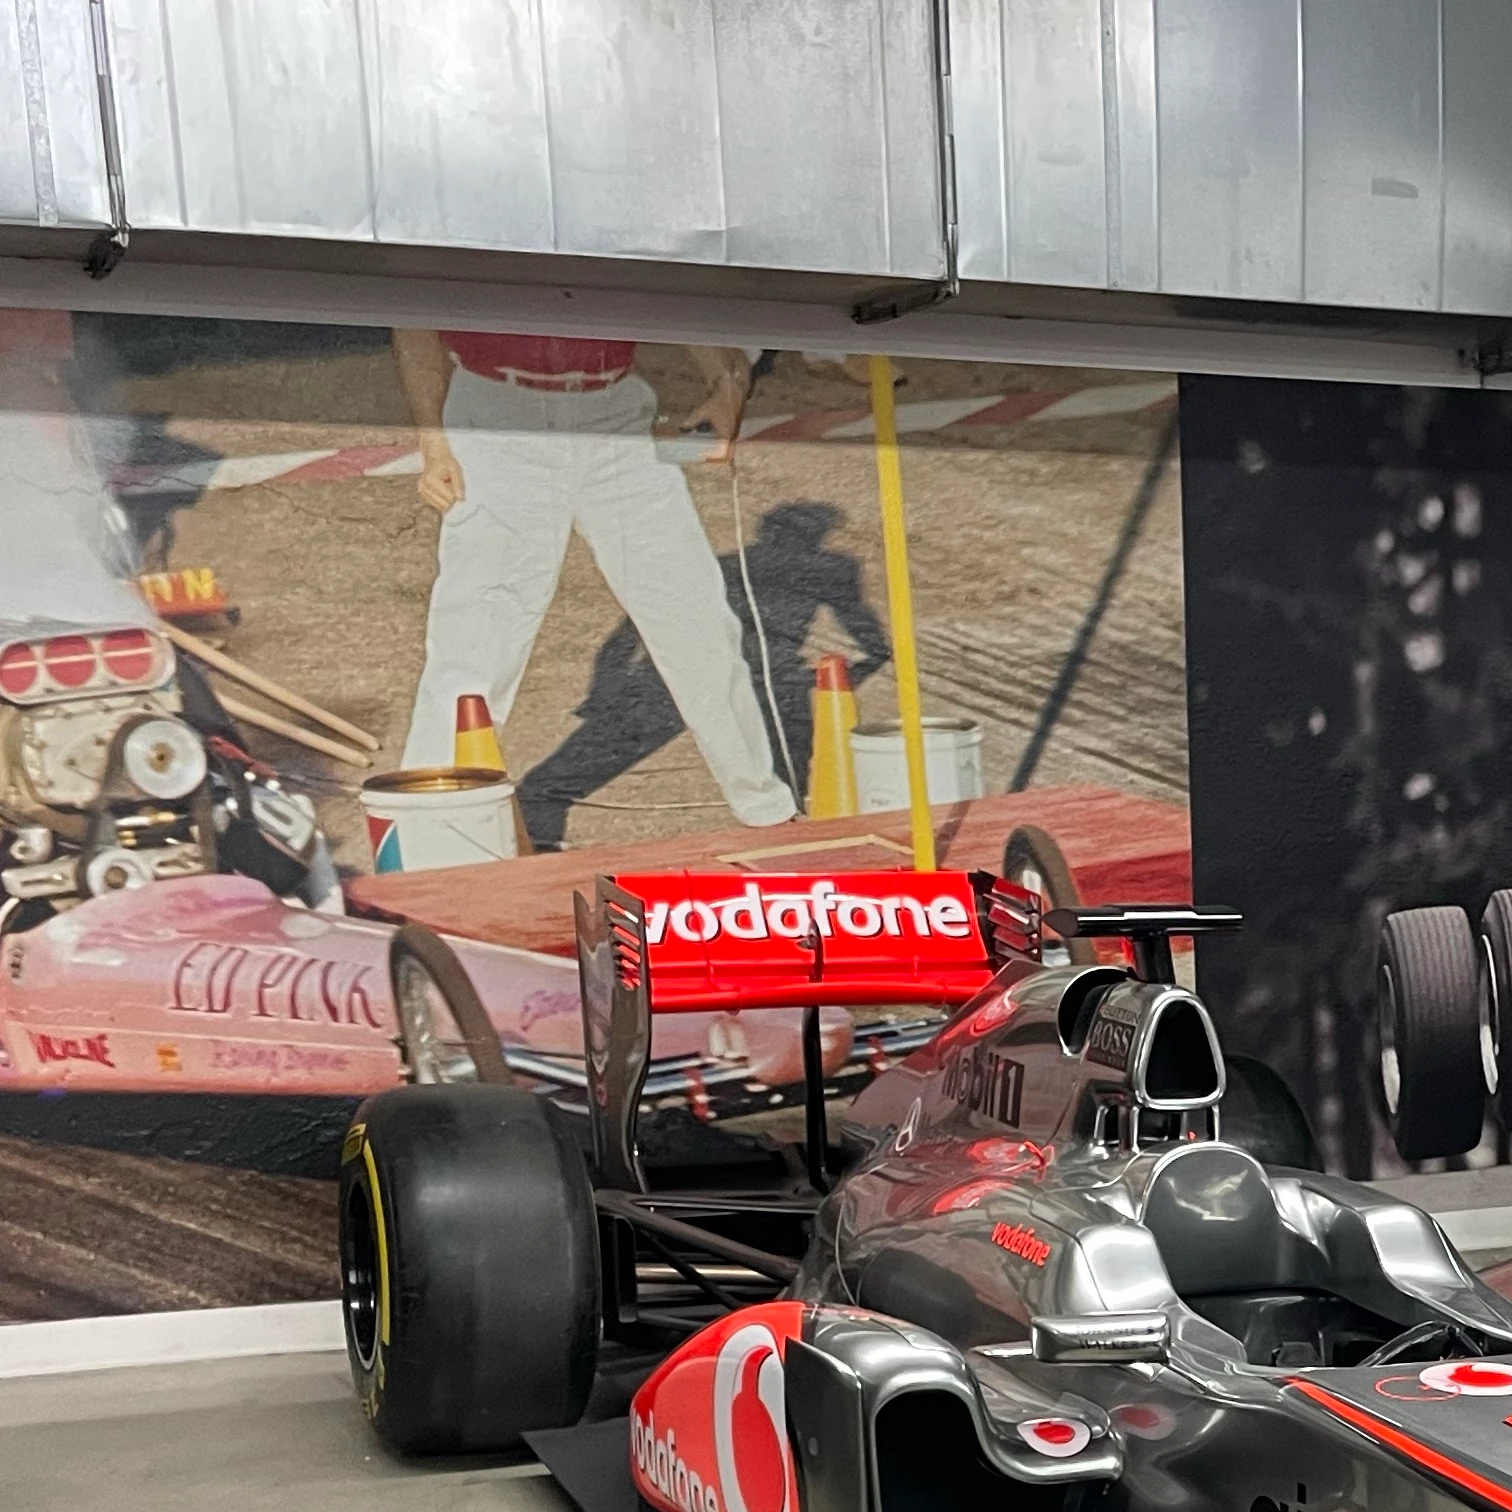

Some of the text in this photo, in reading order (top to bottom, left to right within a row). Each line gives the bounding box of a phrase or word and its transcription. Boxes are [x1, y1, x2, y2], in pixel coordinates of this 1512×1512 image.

[644, 881, 970, 944] vodafone
[1090, 1020, 1132, 1056] BOSS
[941, 1046, 1000, 1118] Mobil
[991, 1221, 1051, 1266] vodafone
